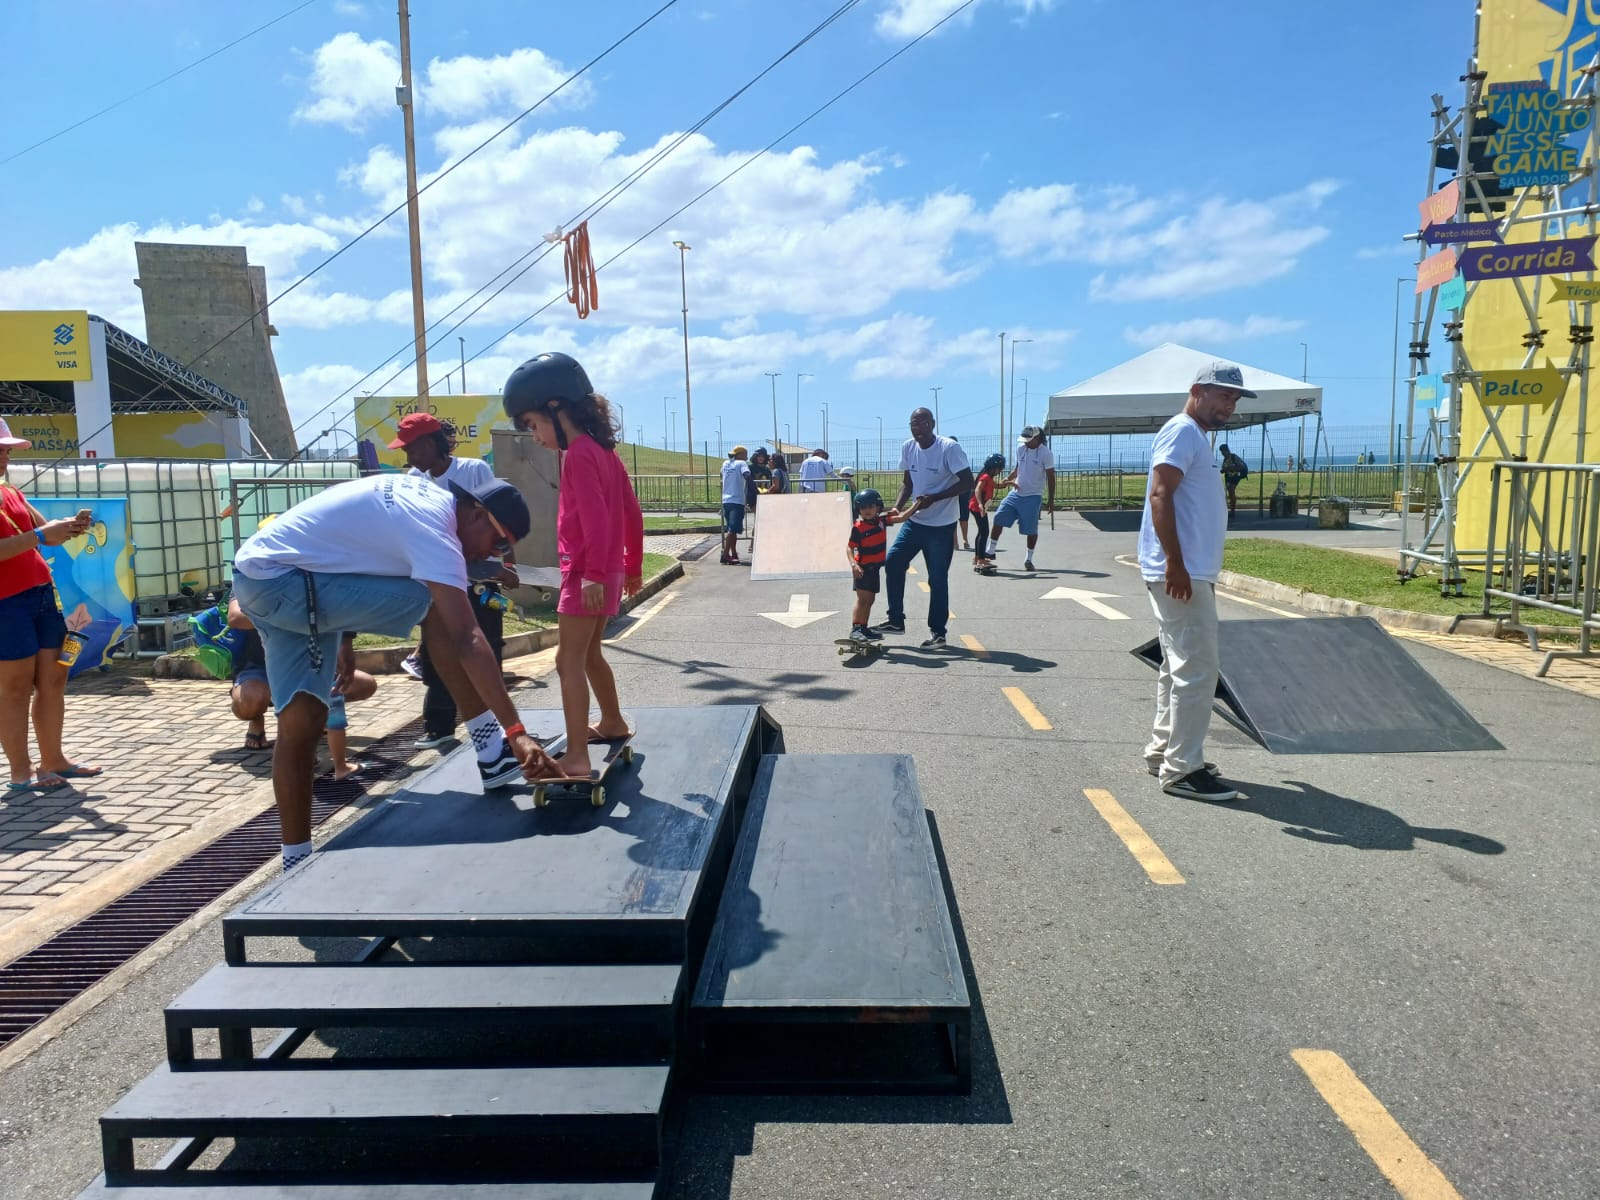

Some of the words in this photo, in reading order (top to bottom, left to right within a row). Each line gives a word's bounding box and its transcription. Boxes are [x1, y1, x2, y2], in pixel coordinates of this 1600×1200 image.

[1482, 90, 1562, 115] TAMO
[1497, 108, 1591, 134] JUNTO
[1485, 131, 1566, 156] NESSE
[1492, 149, 1578, 176] GAME
[1499, 173, 1569, 189] SALVADOR
[1460, 228, 1492, 237] Médico
[1477, 246, 1576, 274] Corrida
[57, 360, 77, 369] VISA
[1485, 379, 1544, 397] Palco
[22, 428, 60, 438] ESPAÇO
